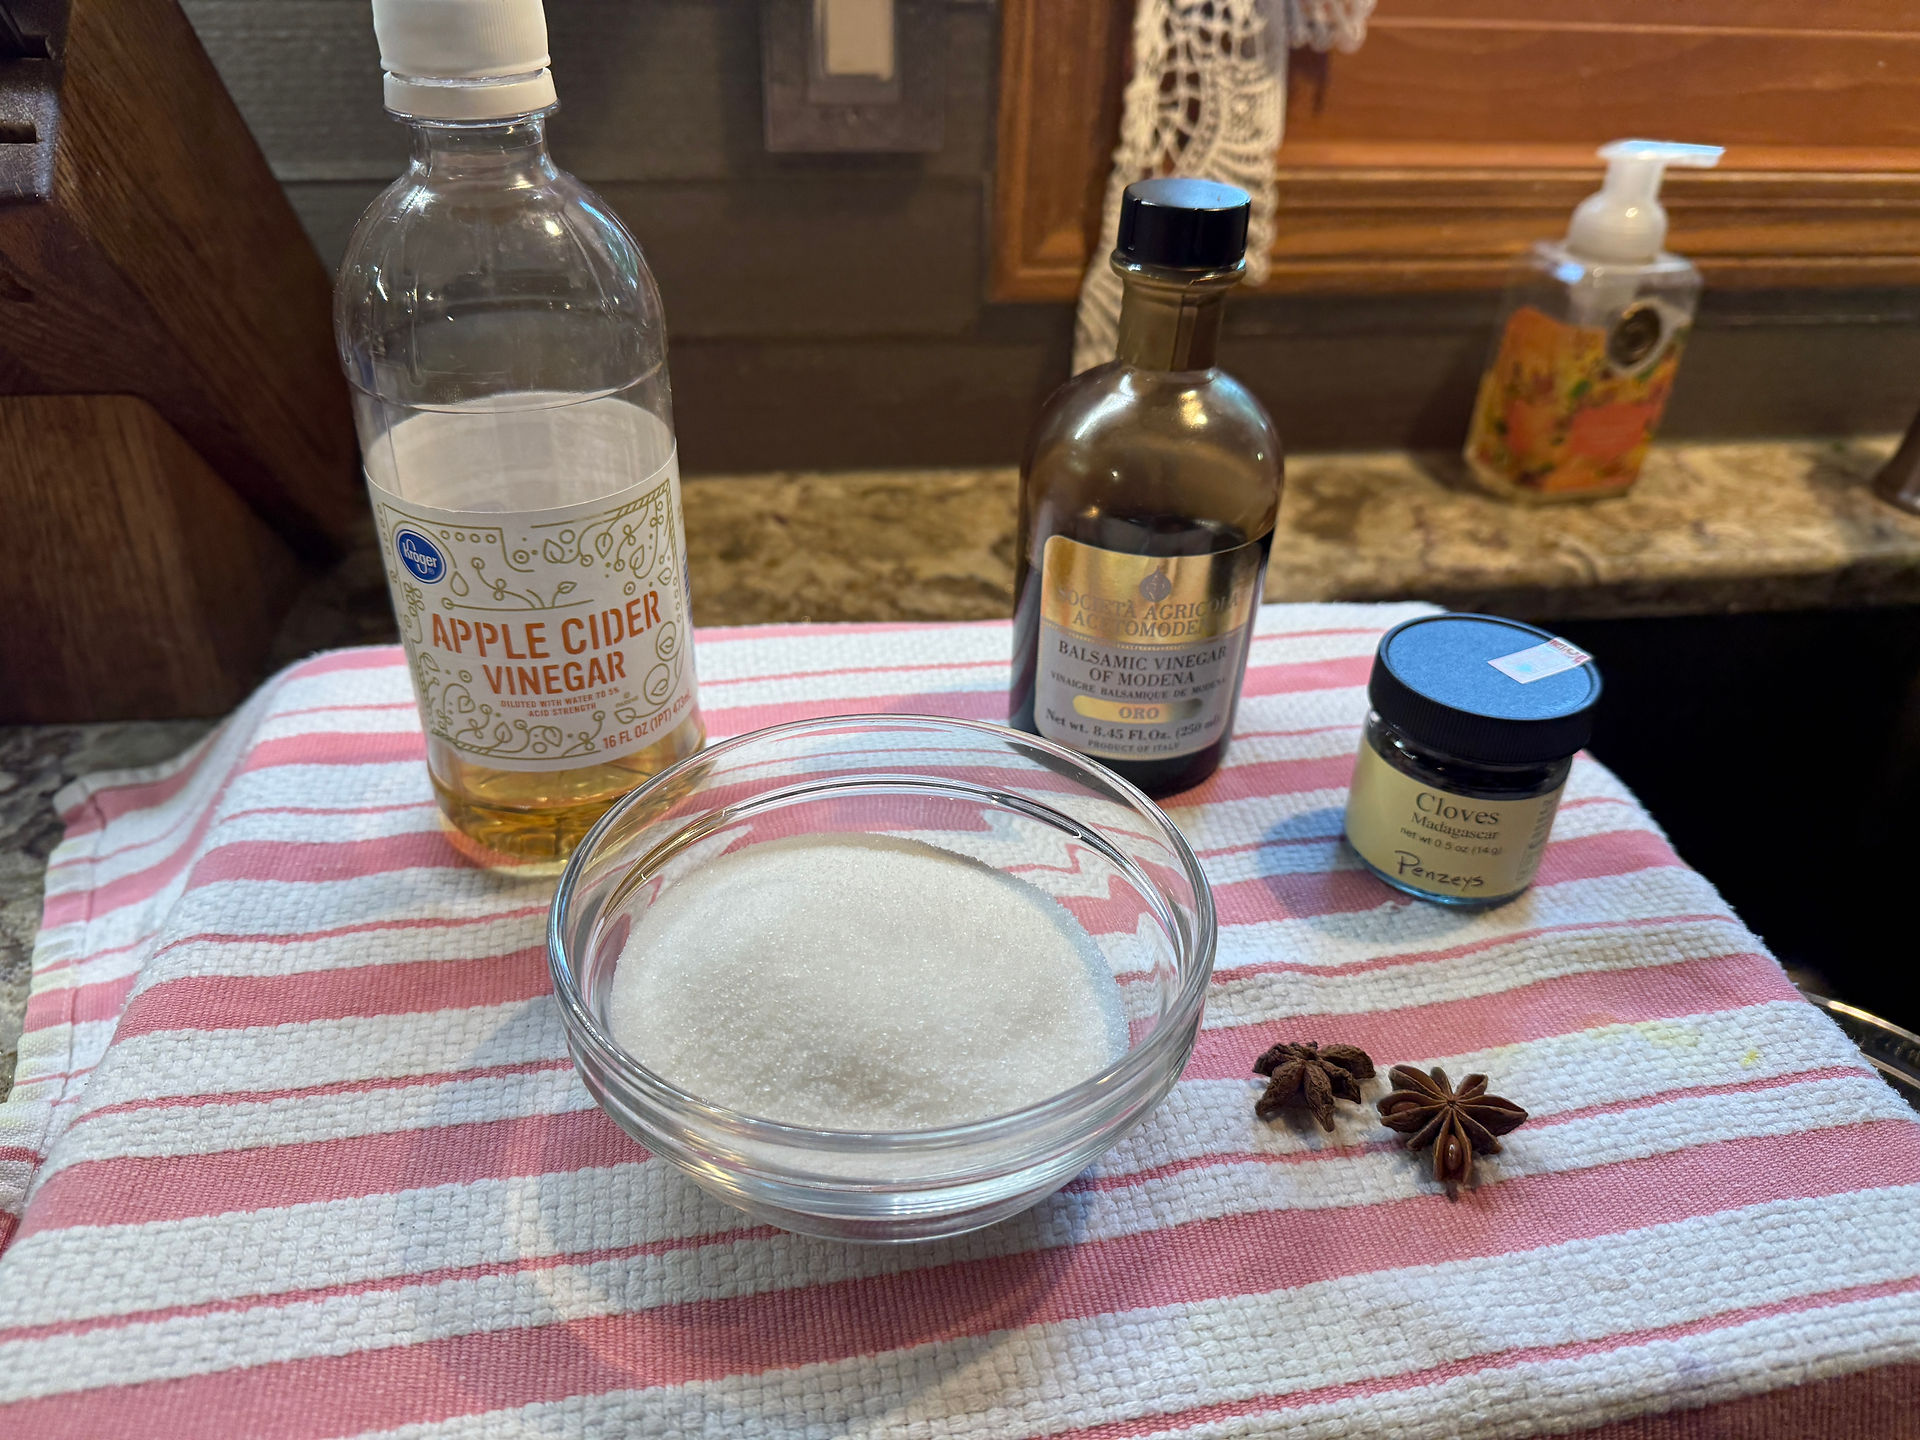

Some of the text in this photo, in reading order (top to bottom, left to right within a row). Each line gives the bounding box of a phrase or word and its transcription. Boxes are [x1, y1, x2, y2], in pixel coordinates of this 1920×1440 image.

[402, 539, 437, 574] Kroger
[431, 590, 662, 660] APPLE CIDER
[1072, 610, 1214, 638] ACETOMODE
[1058, 640, 1227, 671] BALSAMIC VINEGAR
[483, 651, 626, 696] VINEGAR
[1050, 671, 1096, 693] VINAIGRE
[1101, 687, 1168, 701] BALSAMIQUE
[1173, 688, 1186, 698] DE
[1089, 667, 1195, 687] OF MODENA
[501, 699, 537, 709] DILUTED
[540, 699, 562, 708] WITH
[565, 694, 594, 705] WATER
[596, 691, 606, 700] TO
[528, 703, 597, 718] ACID STRENGTH
[1118, 706, 1160, 720] ORO
[602, 736, 617, 750] 16
[619, 730, 633, 744] FL
[635, 722, 649, 738] OZ
[650, 708, 672, 733] (1PT)
[1045, 708, 1066, 727] Net
[1069, 720, 1089, 732] wt.
[1093, 725, 1125, 739] 8.45
[1087, 740, 1180, 751] PRODUCT OF ITALY
[1416, 792, 1500, 825] Cloves
[1400, 826, 1417, 839] net
[1420, 837, 1432, 845] wt
[1455, 845, 1469, 853] oz
[1411, 812, 1499, 839] Madagascar
[1394, 850, 1485, 892] Penzeys
